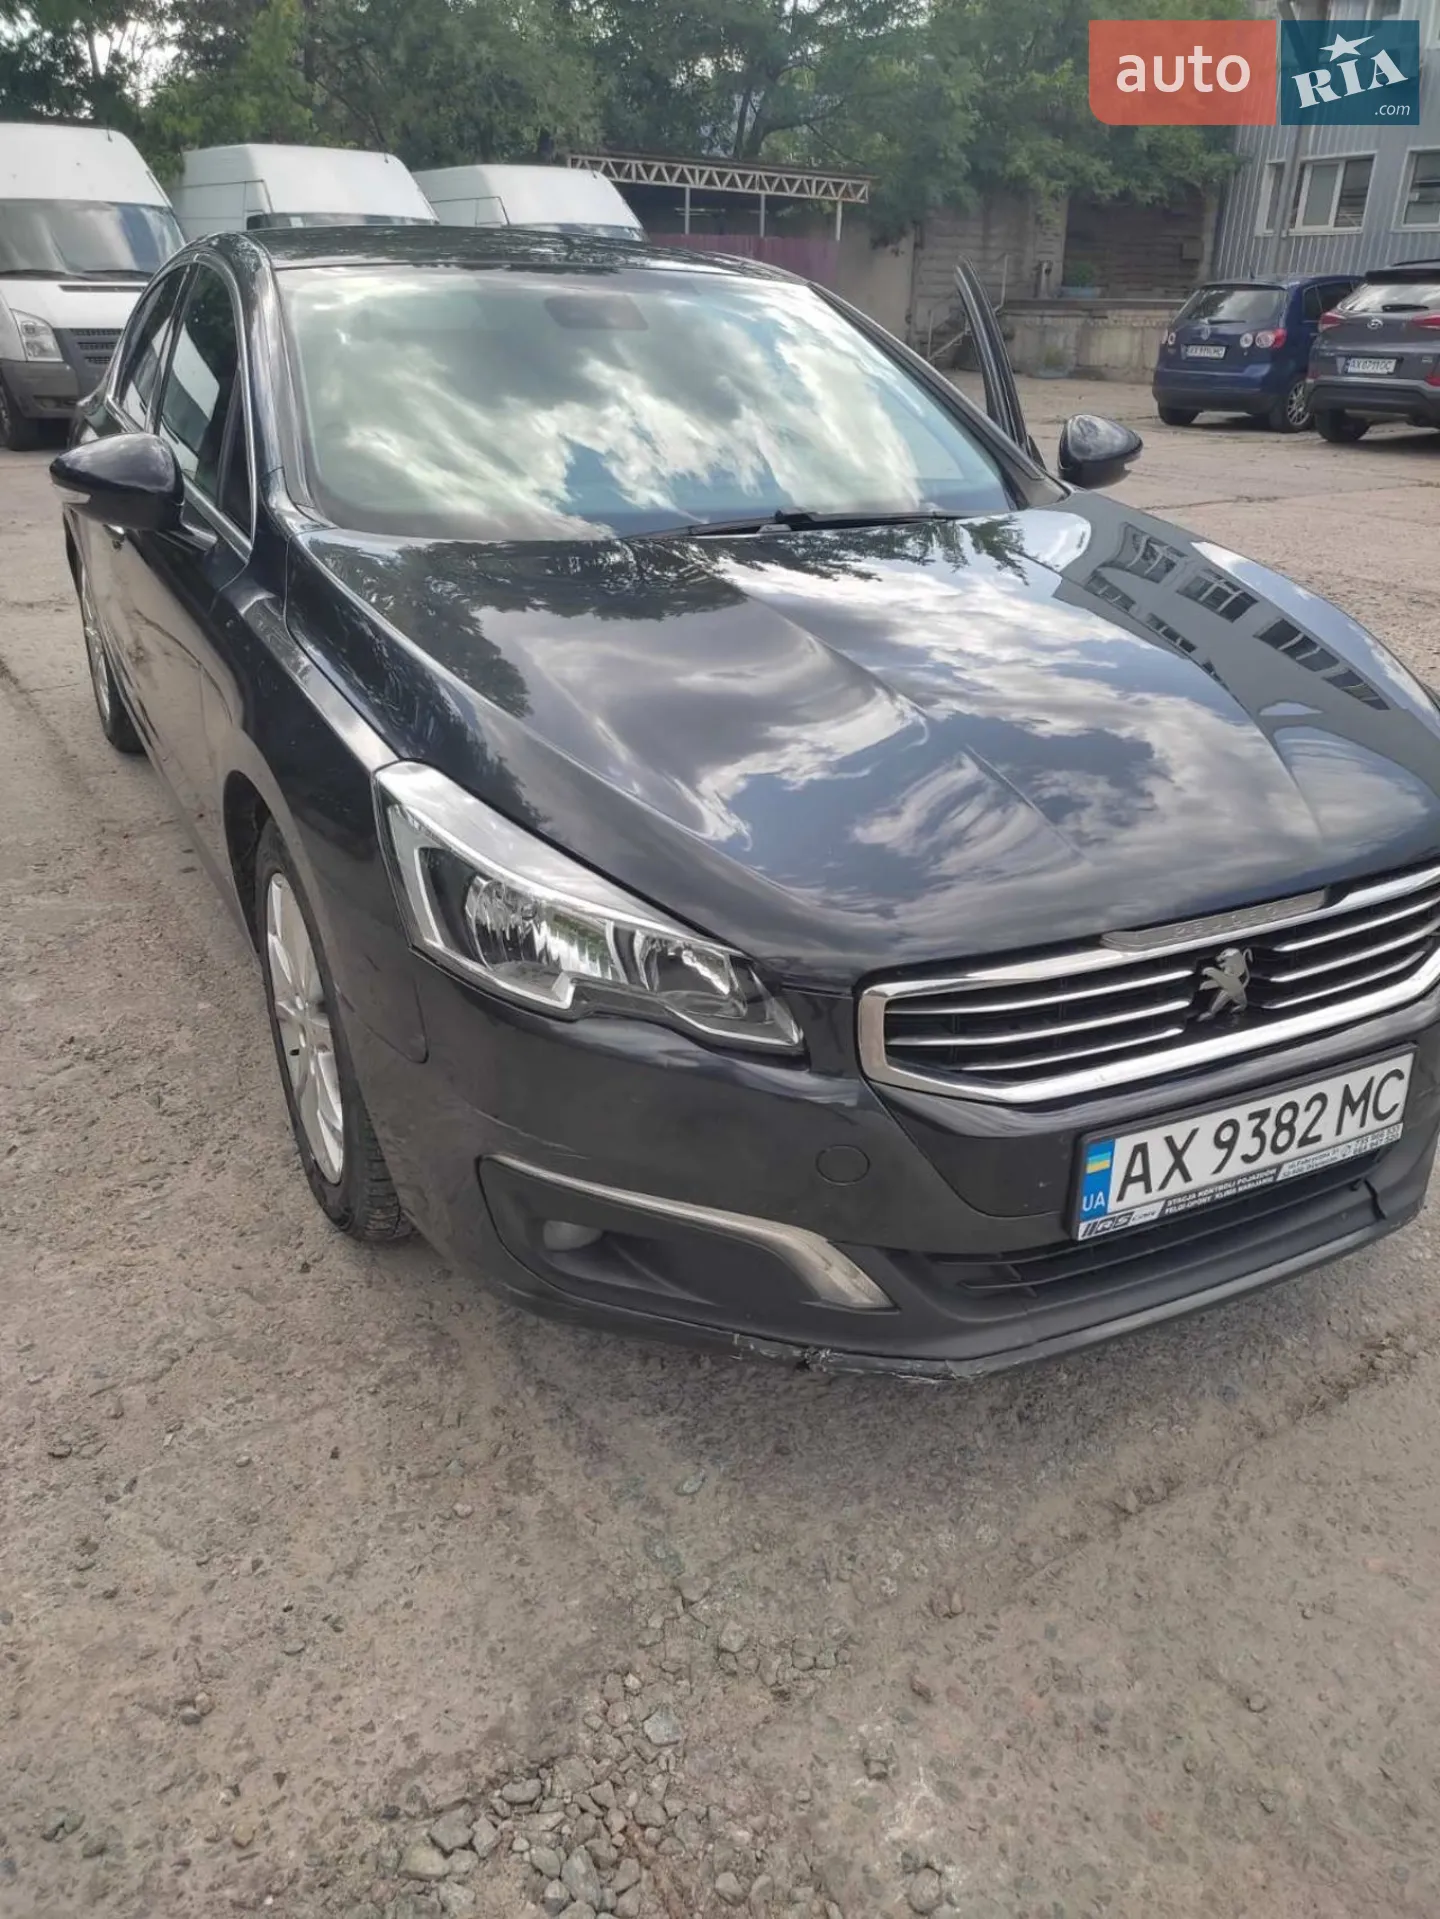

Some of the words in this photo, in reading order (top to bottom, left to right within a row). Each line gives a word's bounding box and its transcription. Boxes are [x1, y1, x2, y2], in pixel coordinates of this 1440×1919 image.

[1116, 1127, 1200, 1202] AX
[1211, 1092, 1328, 1175] 9382
[1335, 1068, 1405, 1136] MC
[1082, 1191, 1106, 1211] UA
